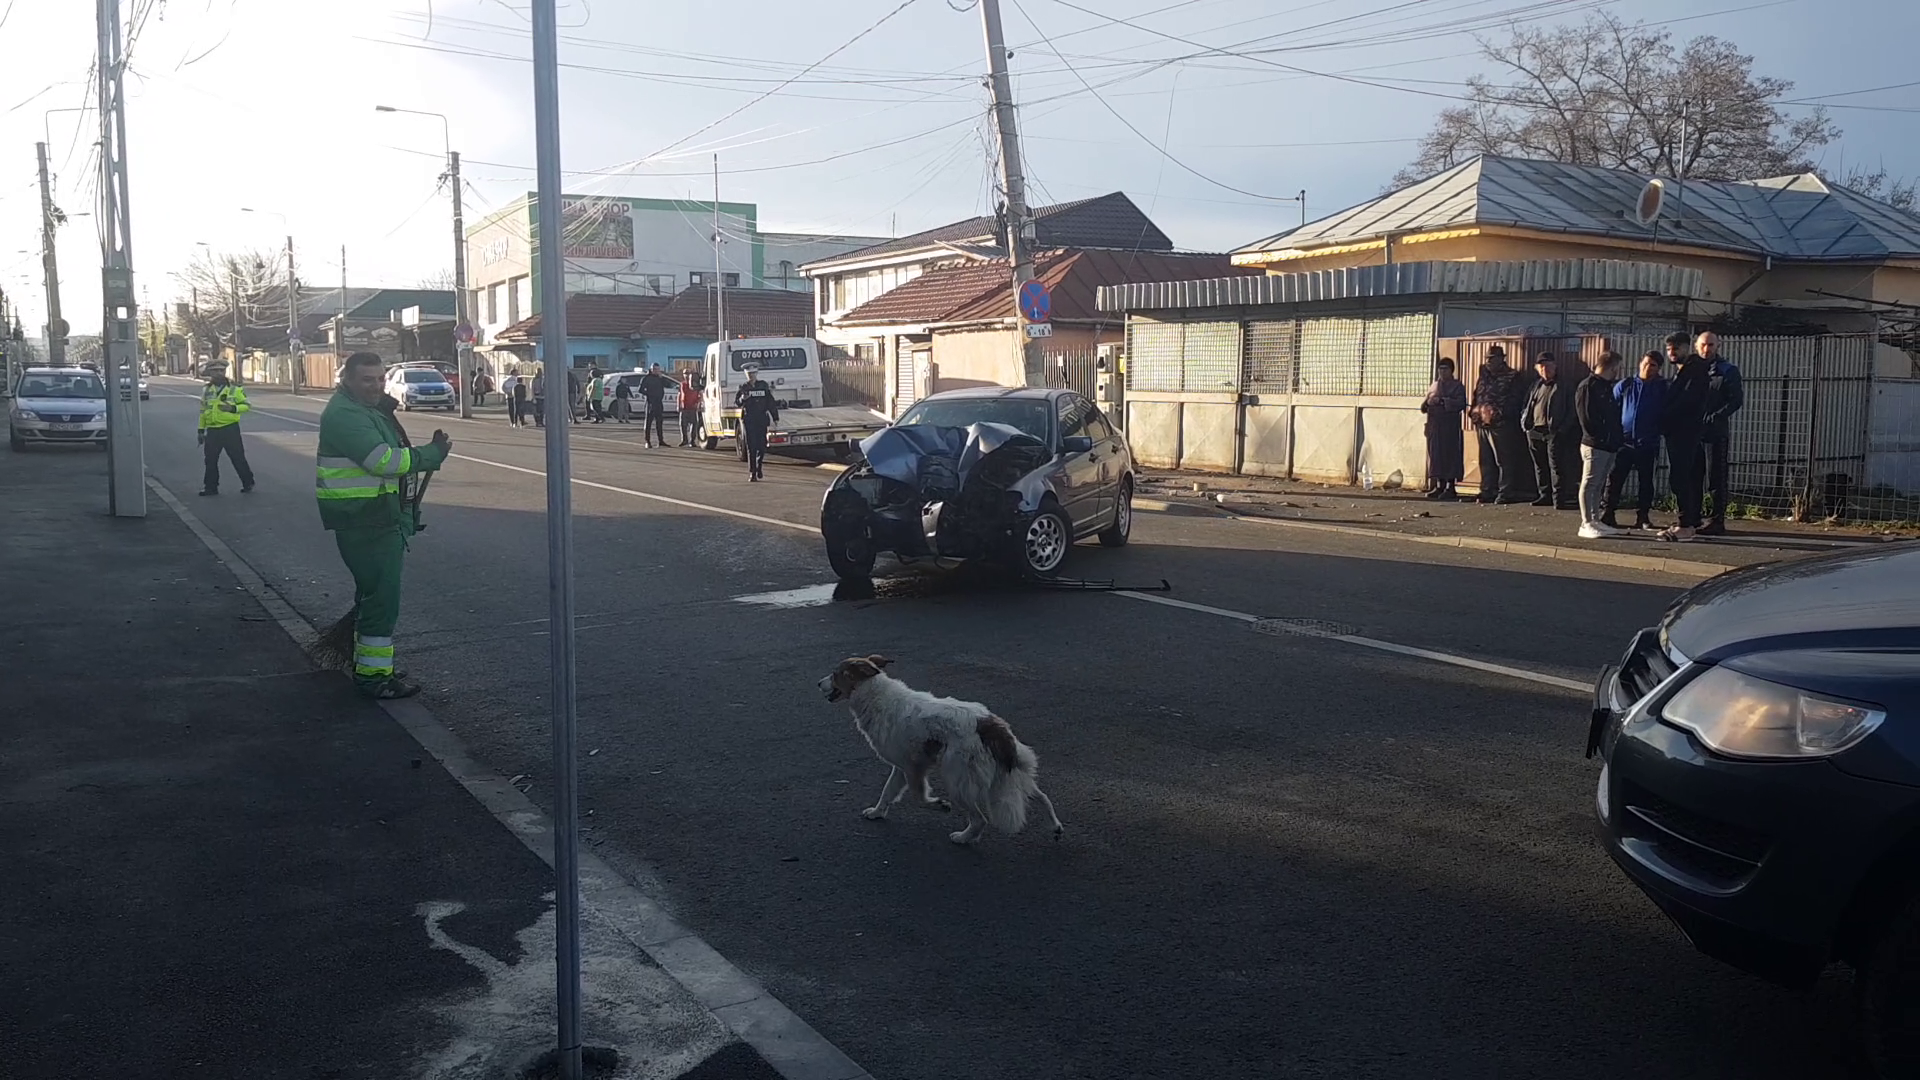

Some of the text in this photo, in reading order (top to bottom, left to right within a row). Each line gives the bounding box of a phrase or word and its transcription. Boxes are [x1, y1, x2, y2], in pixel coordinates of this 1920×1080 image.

[586, 246, 632, 258] UNIVERSAL
[741, 349, 795, 359] 0760 019 311
